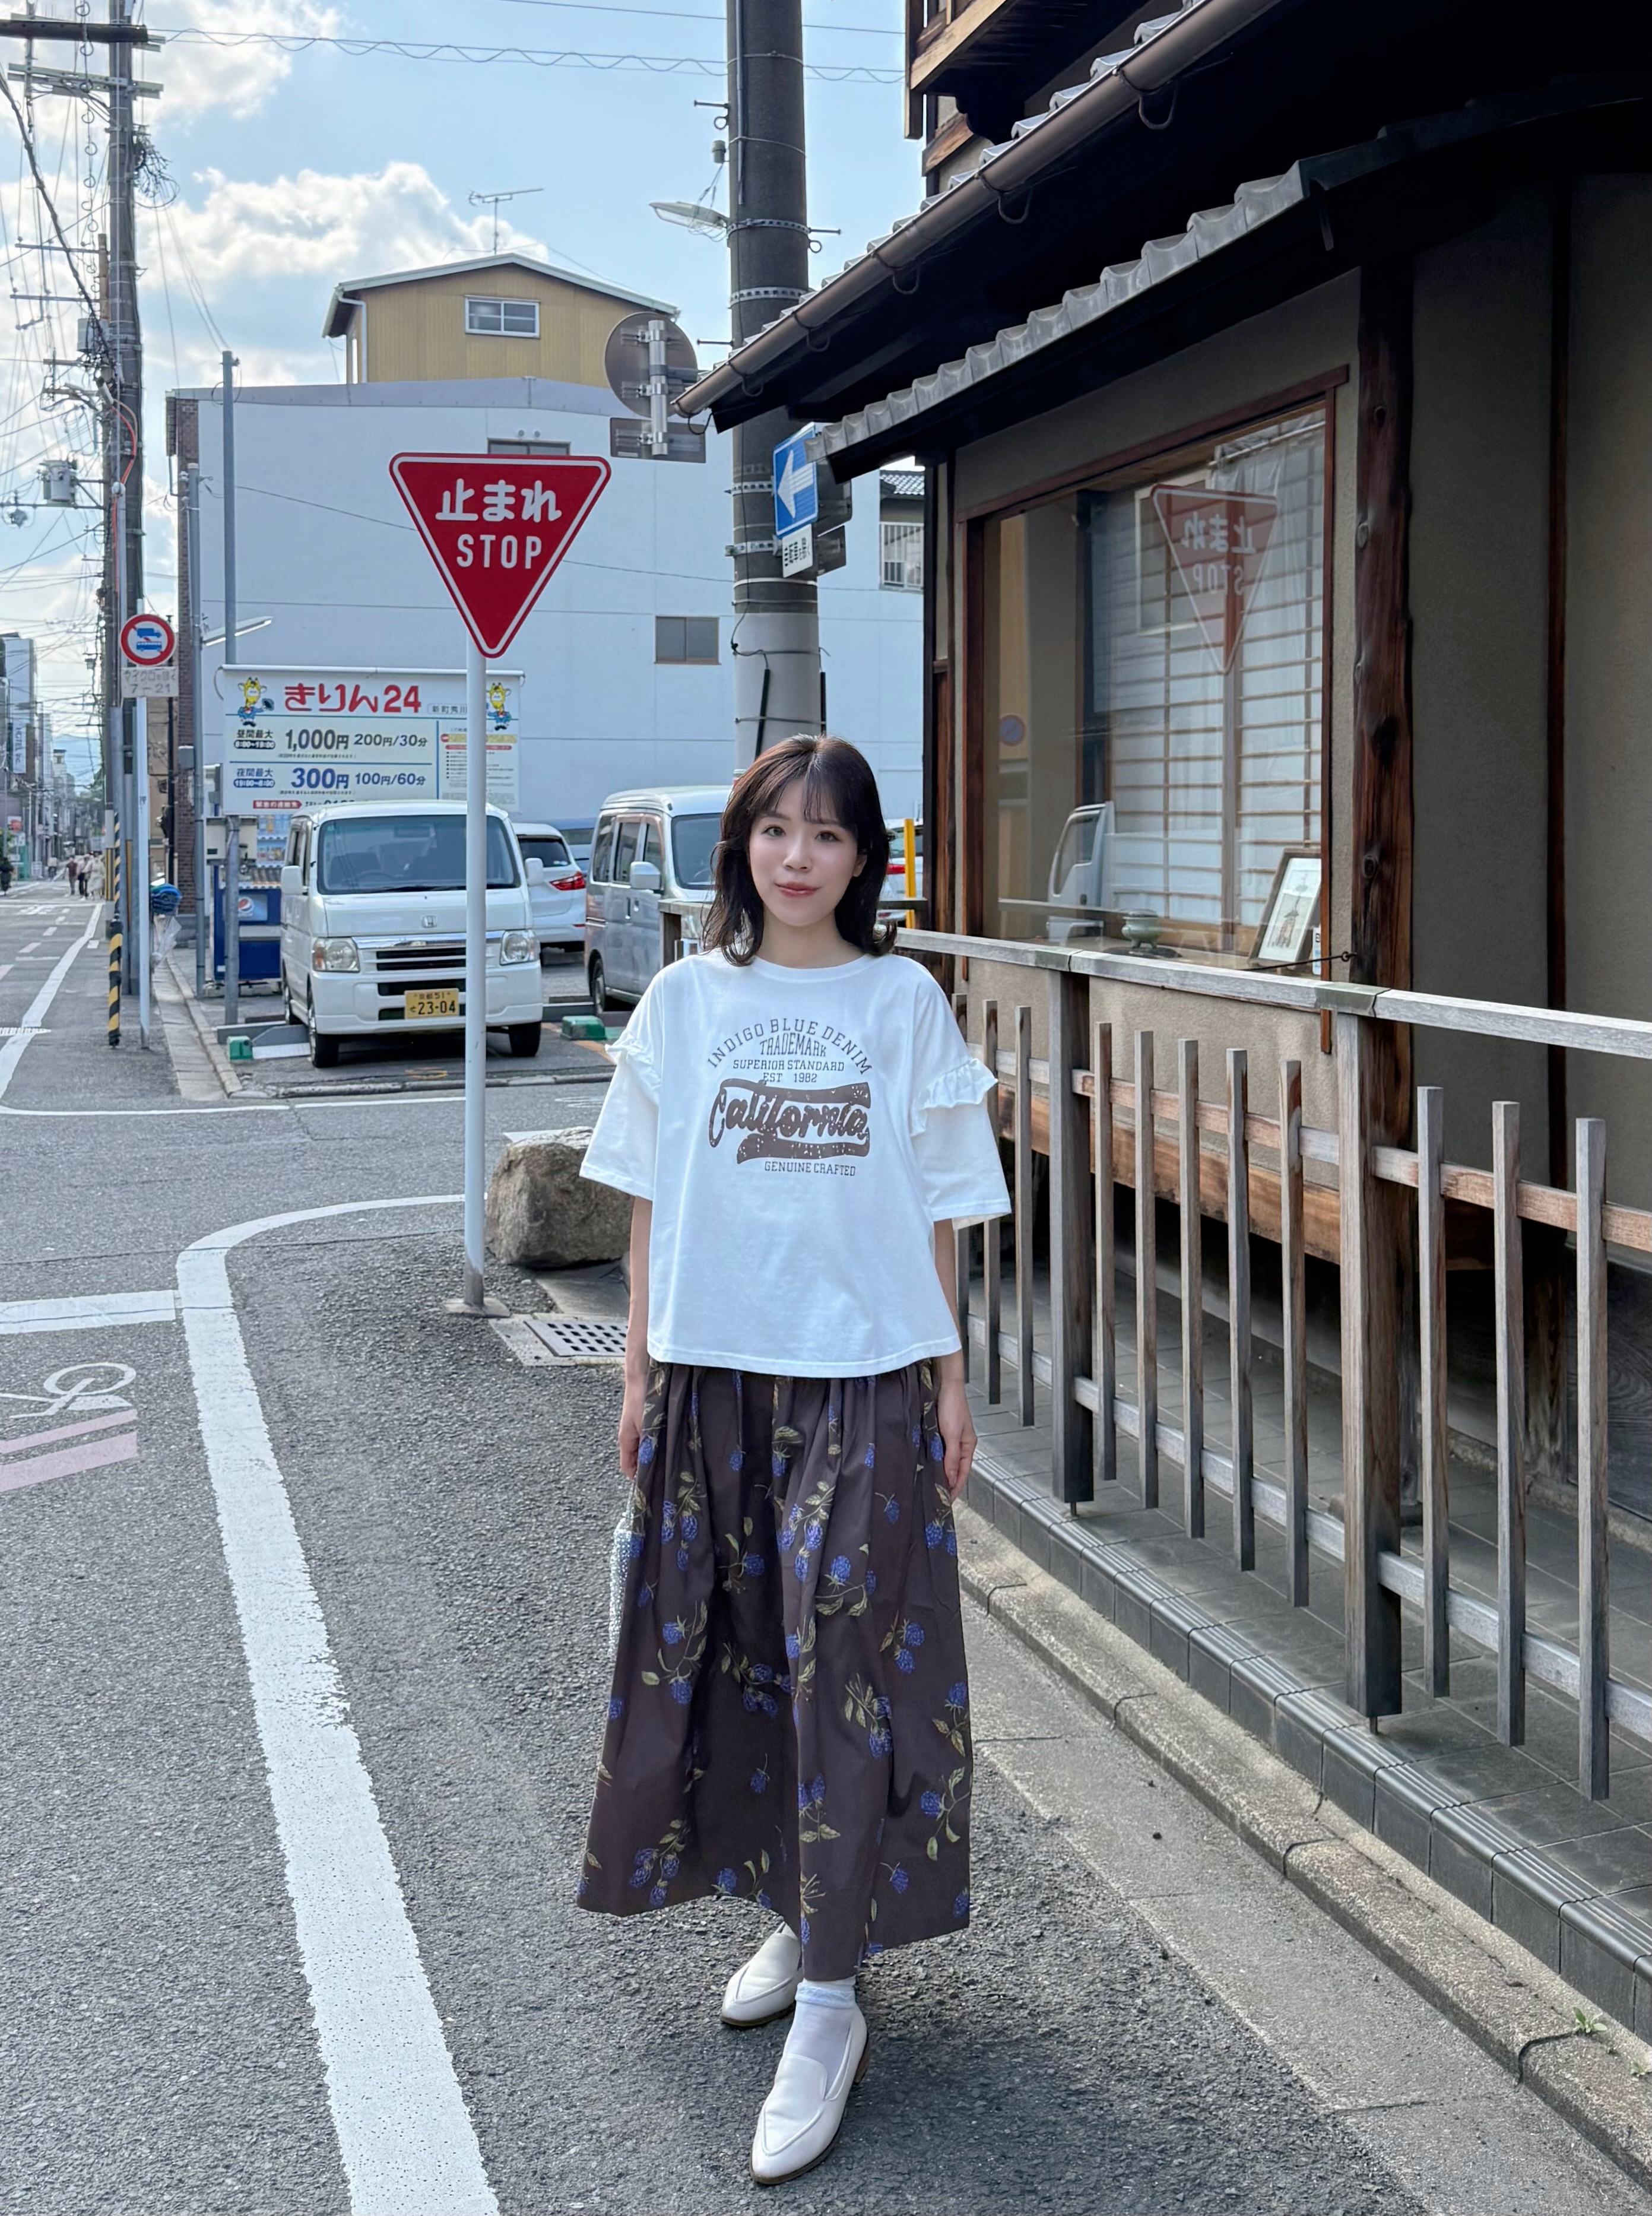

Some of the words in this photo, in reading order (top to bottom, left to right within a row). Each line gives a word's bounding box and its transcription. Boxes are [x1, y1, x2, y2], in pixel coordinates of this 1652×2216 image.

[435, 478, 562, 523] 止まれ
[456, 534, 542, 569] STOP
[284, 683, 421, 712] きりん24
[237, 730, 274, 738] 昼間最大
[286, 729, 349, 752] 1,000円
[354, 734, 427, 747] 200円/30分
[237, 768, 274, 777] 夜間最大
[291, 768, 349, 789] 300円
[355, 772, 426, 785] 100円/60分
[418, 1000, 455, 1015] 23-04
[707, 1023, 764, 1068] INDIGO
[770, 1018, 819, 1035] BLUE
[822, 1026, 872, 1074] DENIM
[759, 1032, 827, 1057] TRADEMARK
[733, 1060, 784, 1070] SUPERIOR
[787, 1060, 845, 1071] STANDARD
[763, 1073, 782, 1082] EST
[794, 1073, 817, 1083] 1982
[709, 1079, 870, 1149] California
[765, 1161, 811, 1173] GENUINE
[814, 1163, 856, 1177] CRAFTED
